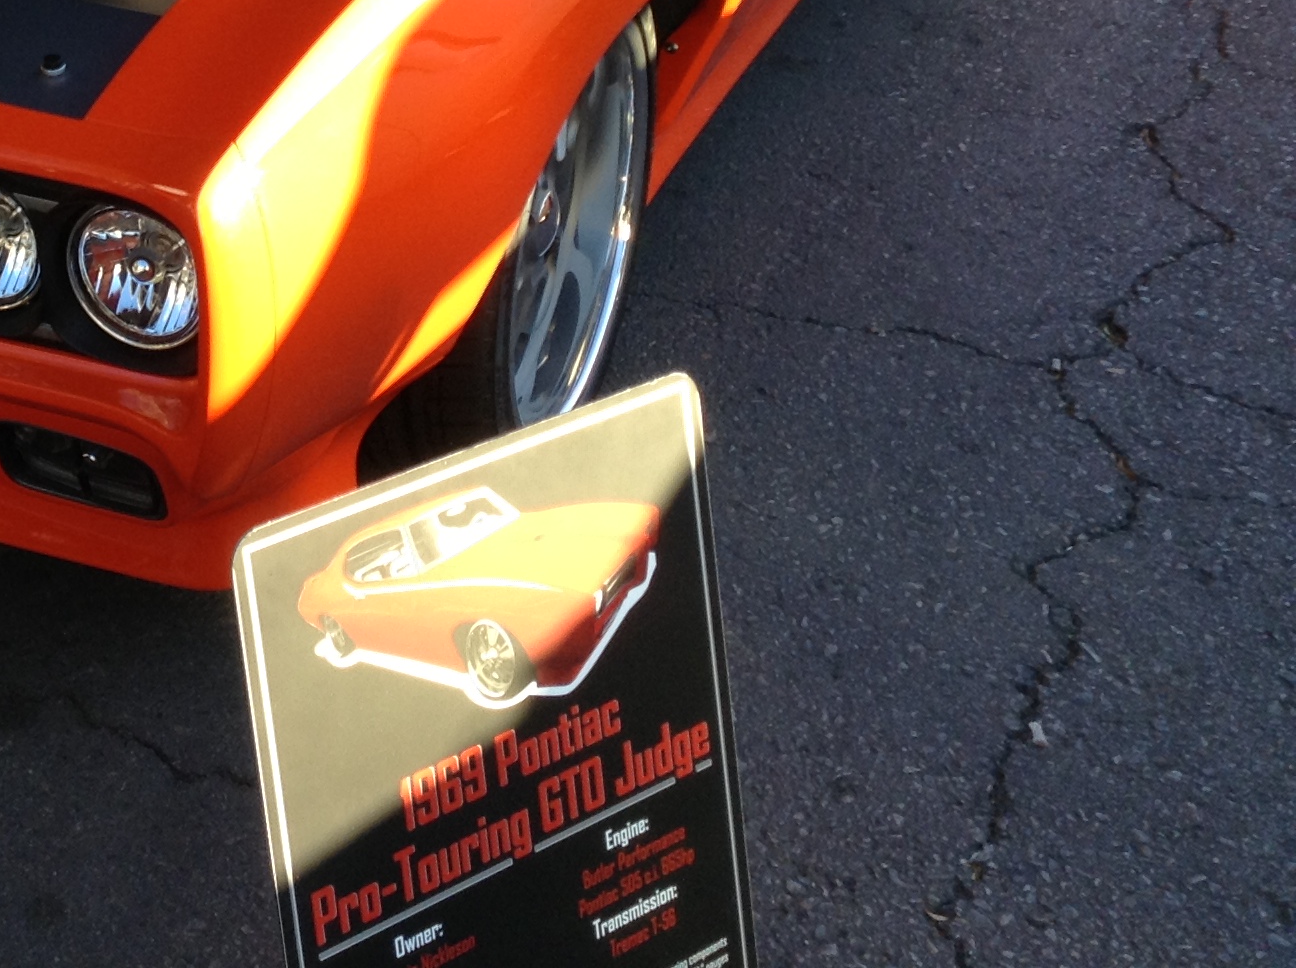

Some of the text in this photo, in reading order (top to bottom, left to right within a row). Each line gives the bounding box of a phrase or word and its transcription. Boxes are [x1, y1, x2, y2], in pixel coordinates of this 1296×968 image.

[400, 698, 622, 831] 1969 Pontiac
[311, 721, 712, 947] Pro-Touring GTO Judge
[605, 818, 650, 851] Engine:
[592, 885, 679, 940] Transmission:
[394, 923, 444, 959] Owner:
